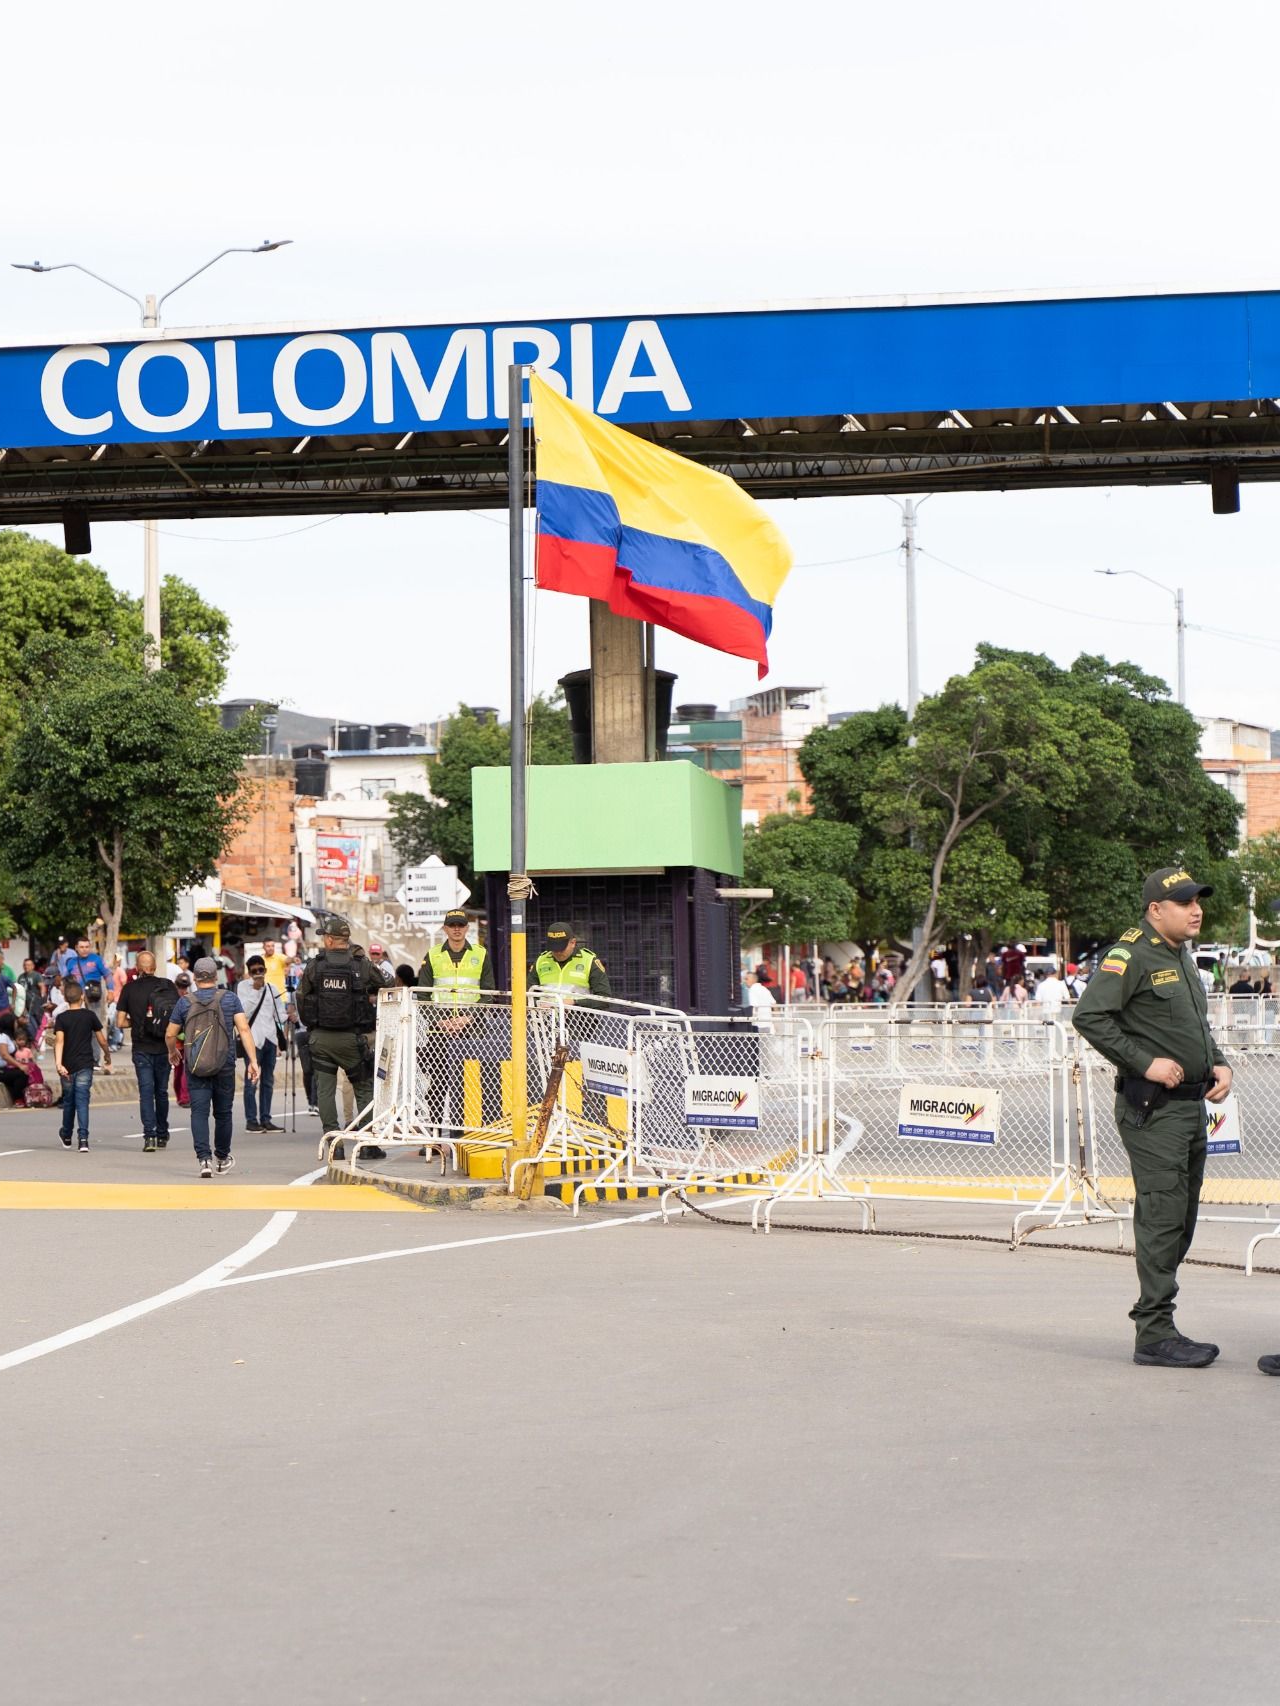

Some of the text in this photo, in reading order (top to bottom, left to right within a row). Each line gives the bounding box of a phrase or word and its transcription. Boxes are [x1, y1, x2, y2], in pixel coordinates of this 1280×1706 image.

[40, 320, 693, 436] COLOMBIA
[323, 978, 347, 990] GAULA
[692, 1087, 741, 1103] MIGRACIÓN
[910, 1098, 975, 1116] MIGRACIÓN
